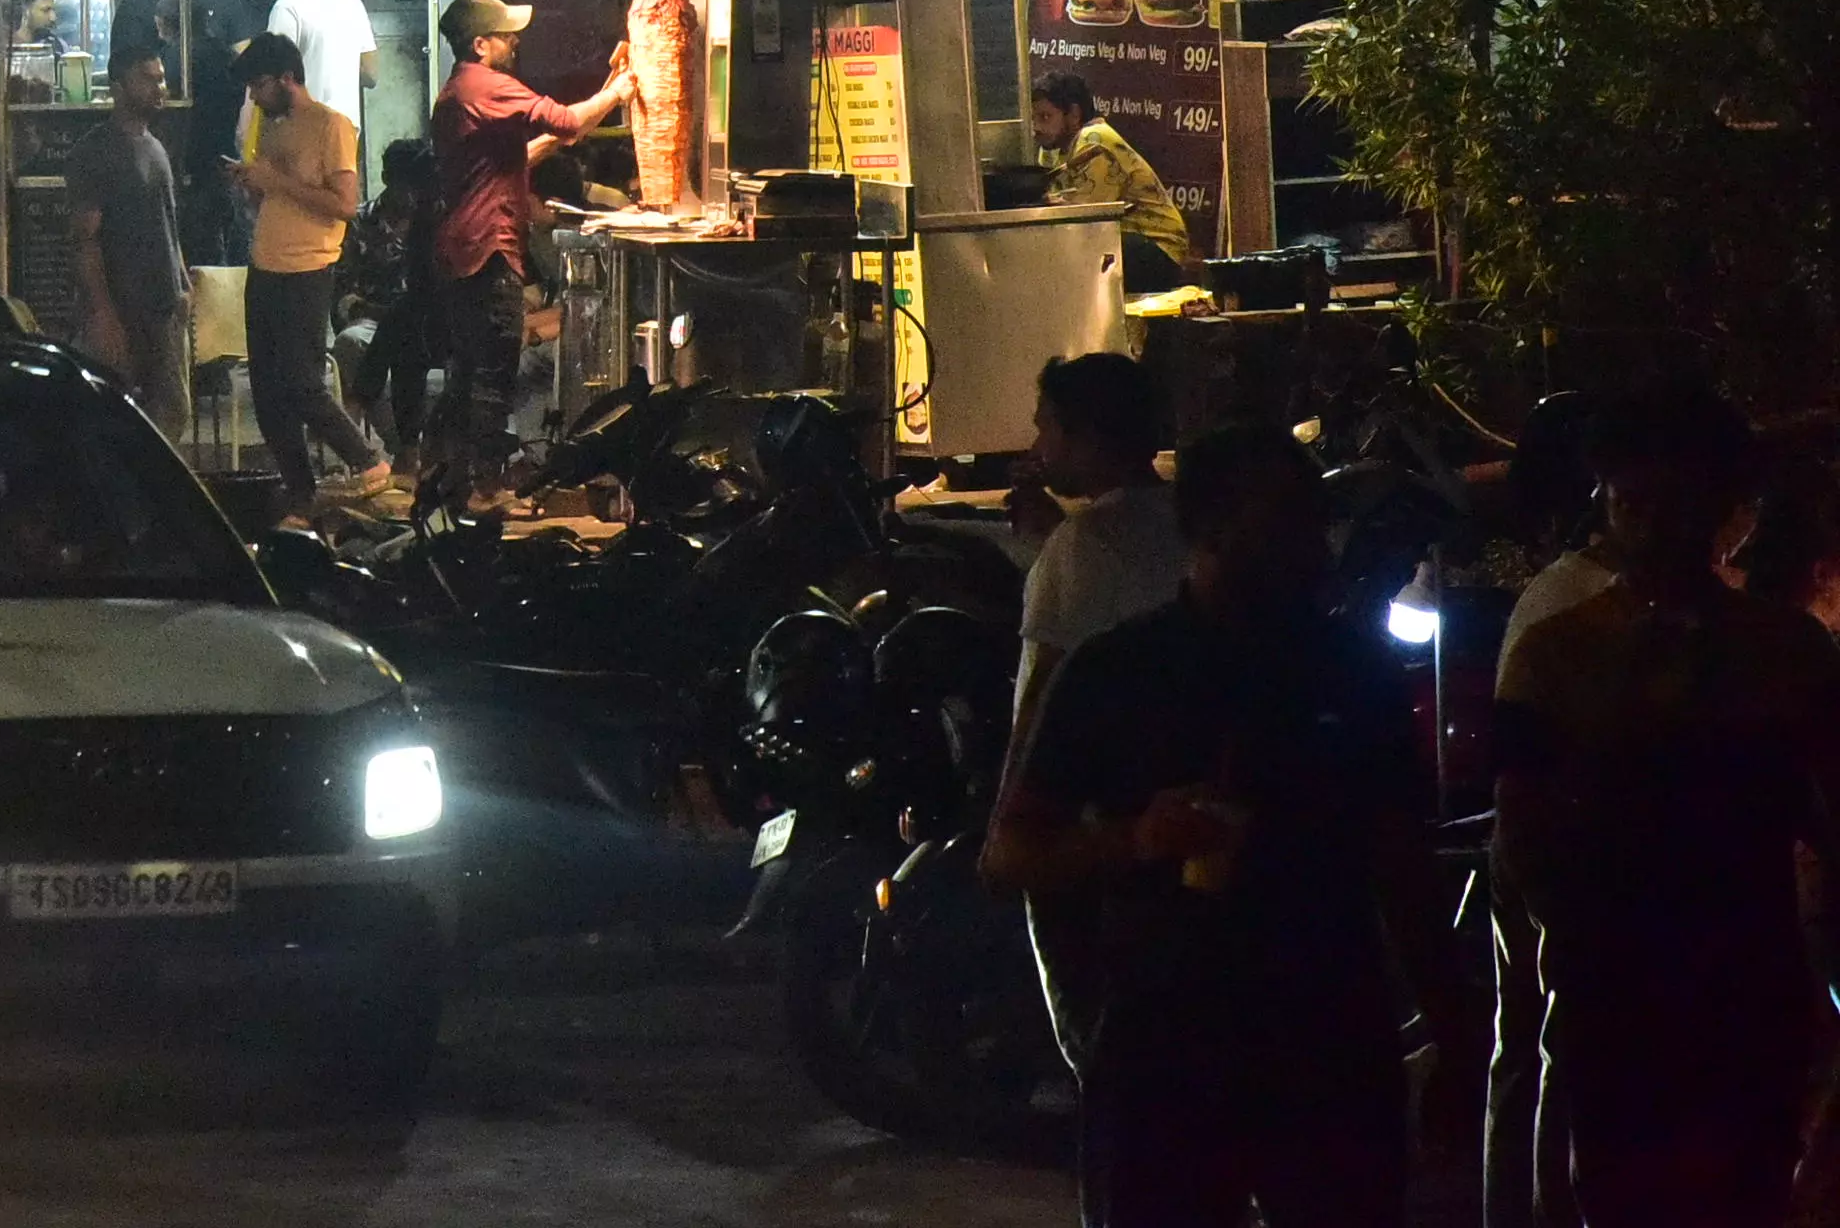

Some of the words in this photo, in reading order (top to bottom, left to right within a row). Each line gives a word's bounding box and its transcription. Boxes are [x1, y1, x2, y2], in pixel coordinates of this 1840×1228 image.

[834, 30, 875, 53] MAGGI
[1029, 38, 1049, 59] Any
[1049, 39, 1057, 56] 2
[1058, 39, 1095, 61] Burgers
[1097, 41, 1115, 62] Veg
[1117, 42, 1125, 58] &
[1127, 43, 1146, 60] Non
[1148, 44, 1167, 65] Veg
[1183, 44, 1219, 72] 99/-
[1092, 96, 1111, 117] Veg
[1112, 98, 1120, 114] &
[1122, 97, 1142, 114] Non
[1143, 100, 1163, 119] Veg
[1173, 106, 1219, 132] 149/-
